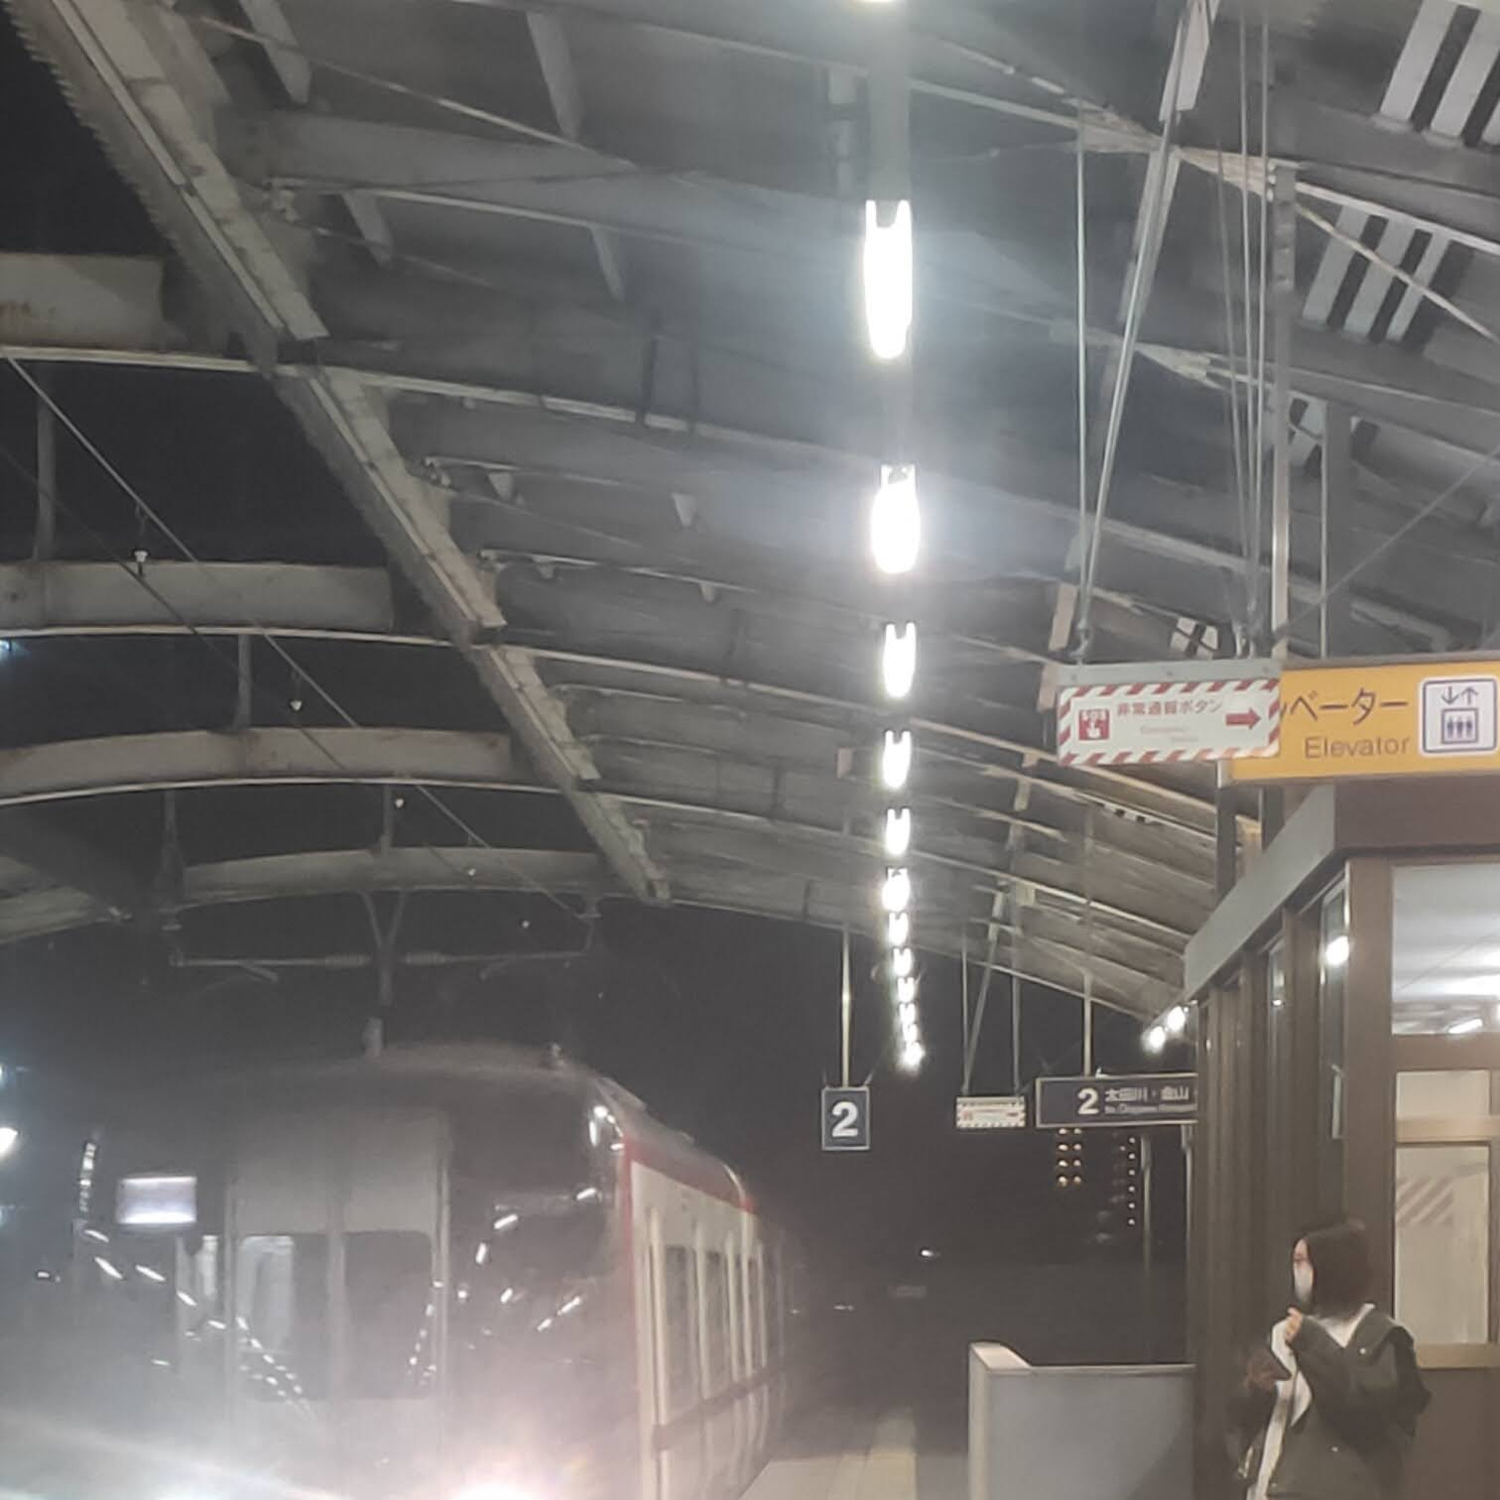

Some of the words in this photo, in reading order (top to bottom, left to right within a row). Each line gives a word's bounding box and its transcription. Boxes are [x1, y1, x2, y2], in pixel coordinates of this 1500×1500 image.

[1281, 687, 1409, 726] ベーター
[1304, 736, 1410, 759] Elevator
[1077, 1087, 1099, 1115] 2
[832, 1101, 858, 1137] 2
